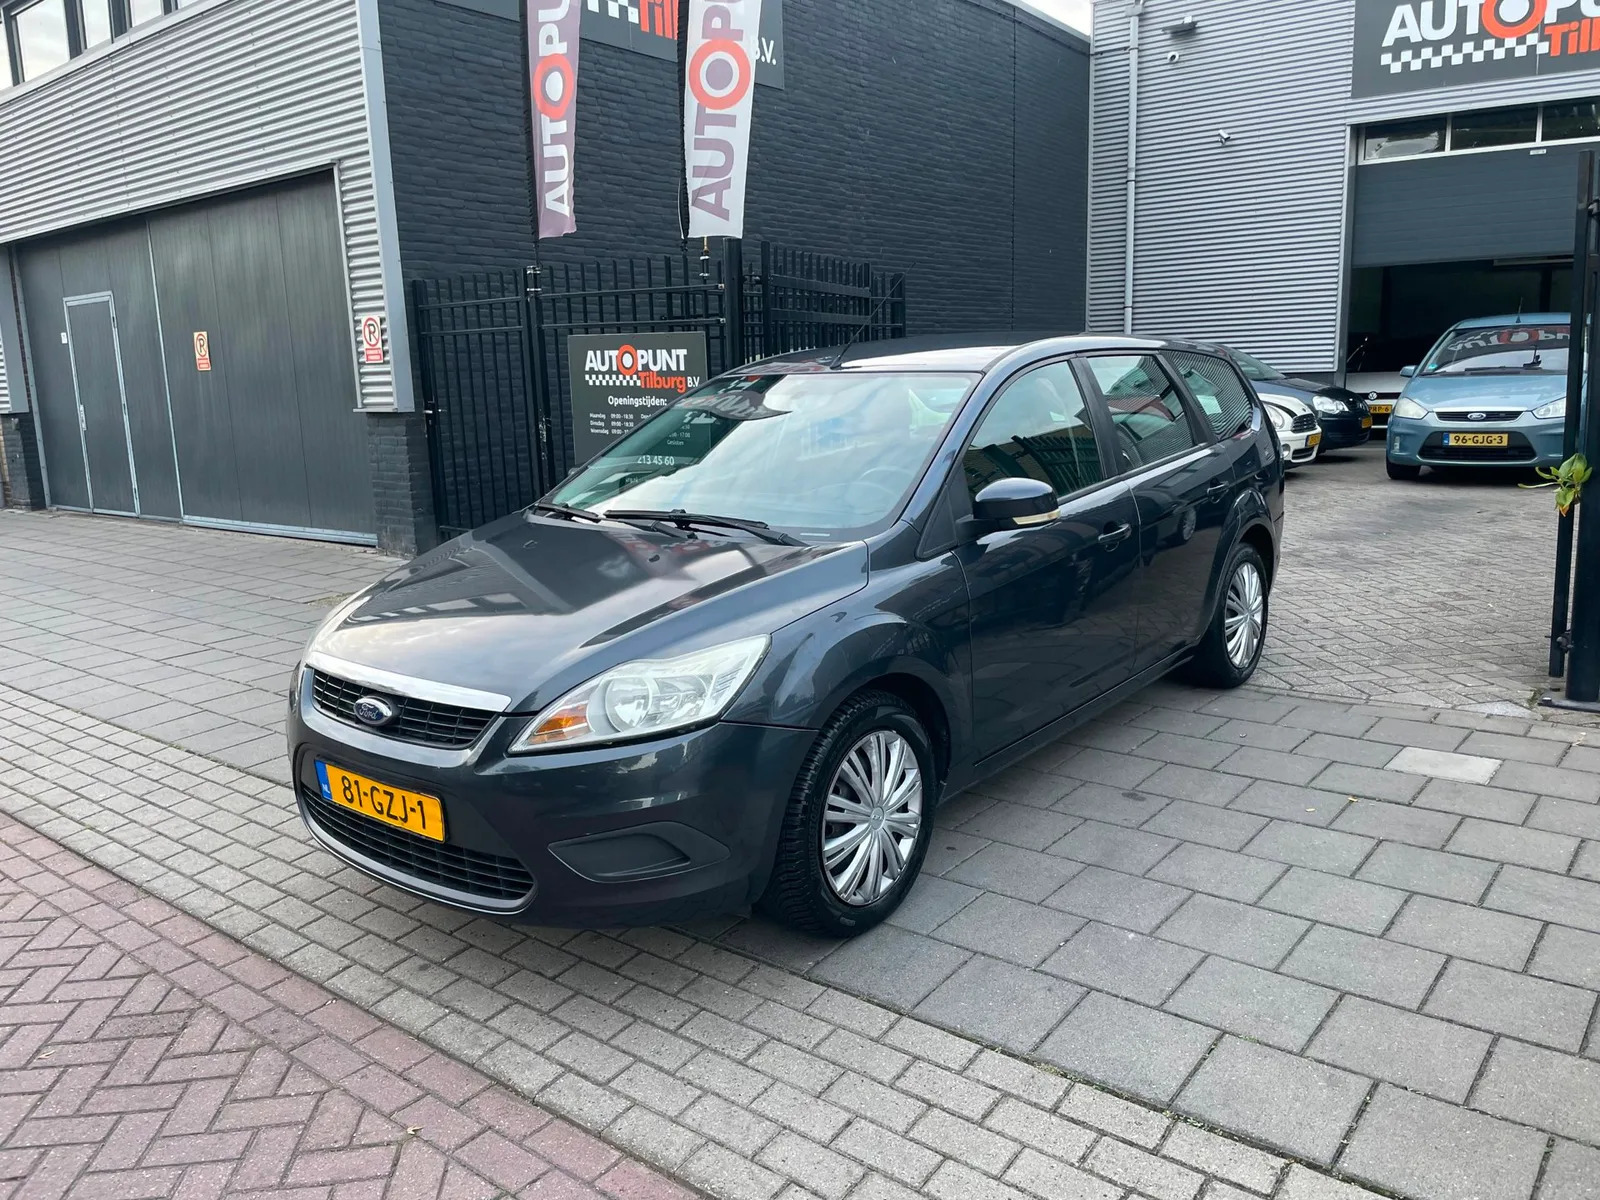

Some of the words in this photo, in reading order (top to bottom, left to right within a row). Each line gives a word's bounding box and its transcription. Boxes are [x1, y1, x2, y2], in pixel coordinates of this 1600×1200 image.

[689, 0, 751, 222] AUTOP
[585, 344, 687, 376] AUTOPUNT
[638, 371, 686, 393] Tilburg
[608, 395, 667, 407] Openingstijden:
[1454, 435, 1503, 445] 96-GJG-3
[653, 455, 663, 465] 45
[664, 456, 675, 466] 60
[358, 702, 379, 720] Ford
[341, 774, 427, 830] 81-GZJ-1
